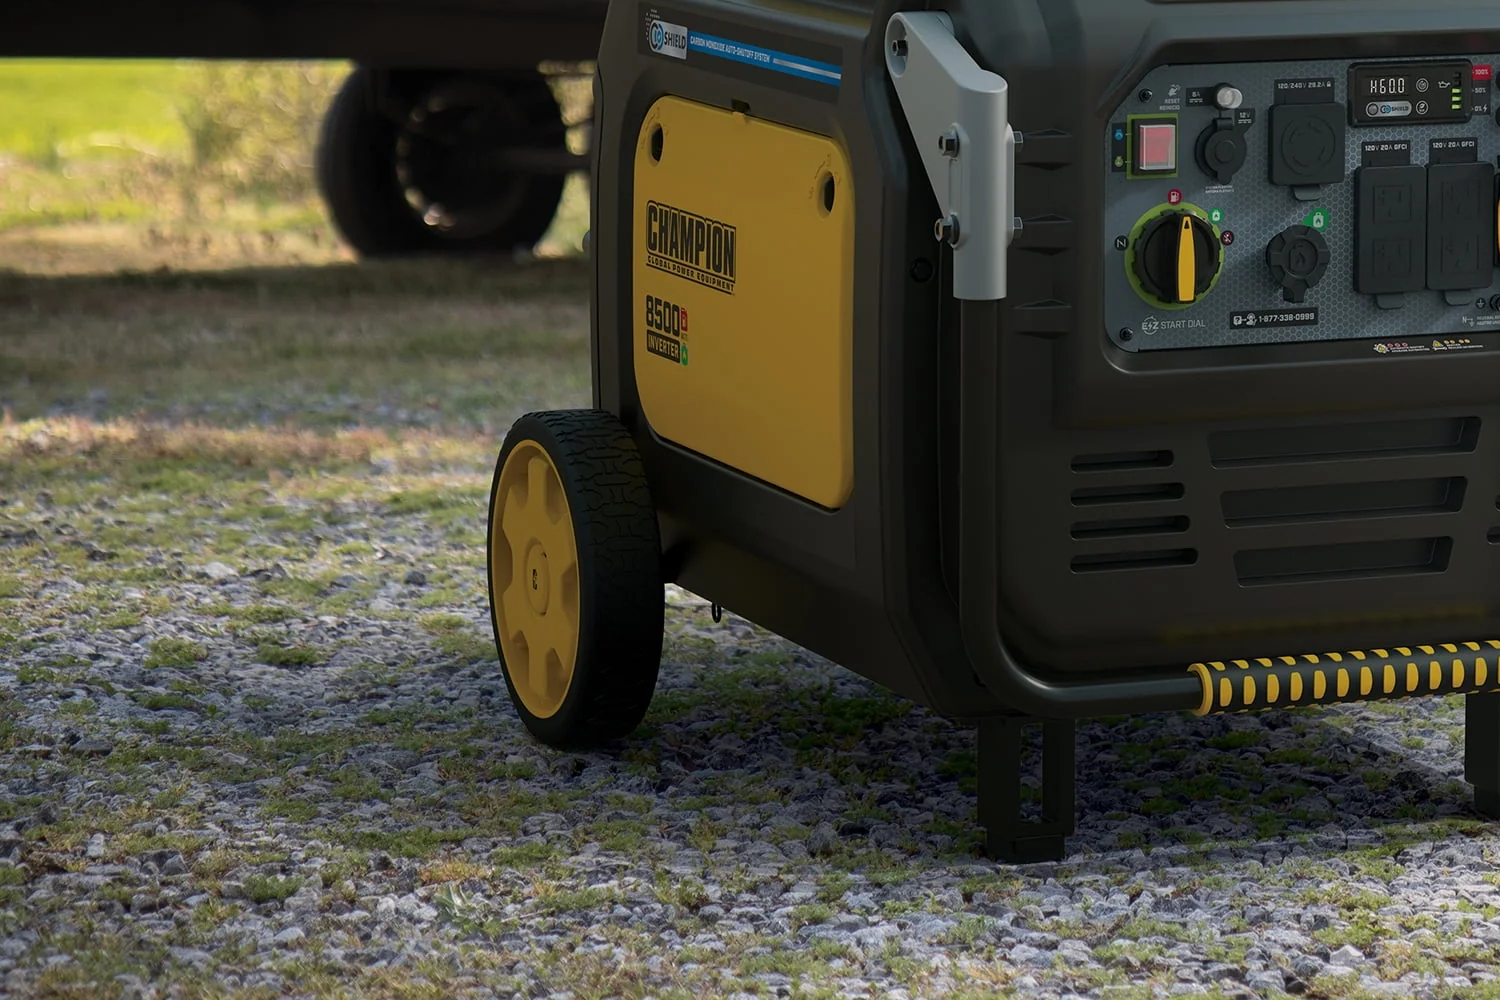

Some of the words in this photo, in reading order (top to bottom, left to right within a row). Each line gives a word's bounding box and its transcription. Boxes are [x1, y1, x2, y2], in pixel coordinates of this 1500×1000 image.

[664, 31, 687, 50] SHIELD
[646, 203, 736, 280] CHAMPION
[647, 255, 671, 270] GLOBAL
[672, 263, 695, 278] POWER
[696, 271, 735, 292] EQUIPMENT
[646, 294, 680, 337] 8500
[1160, 320, 1186, 329] START
[1187, 319, 1206, 328] DIAL
[648, 333, 679, 359] INVERTER
